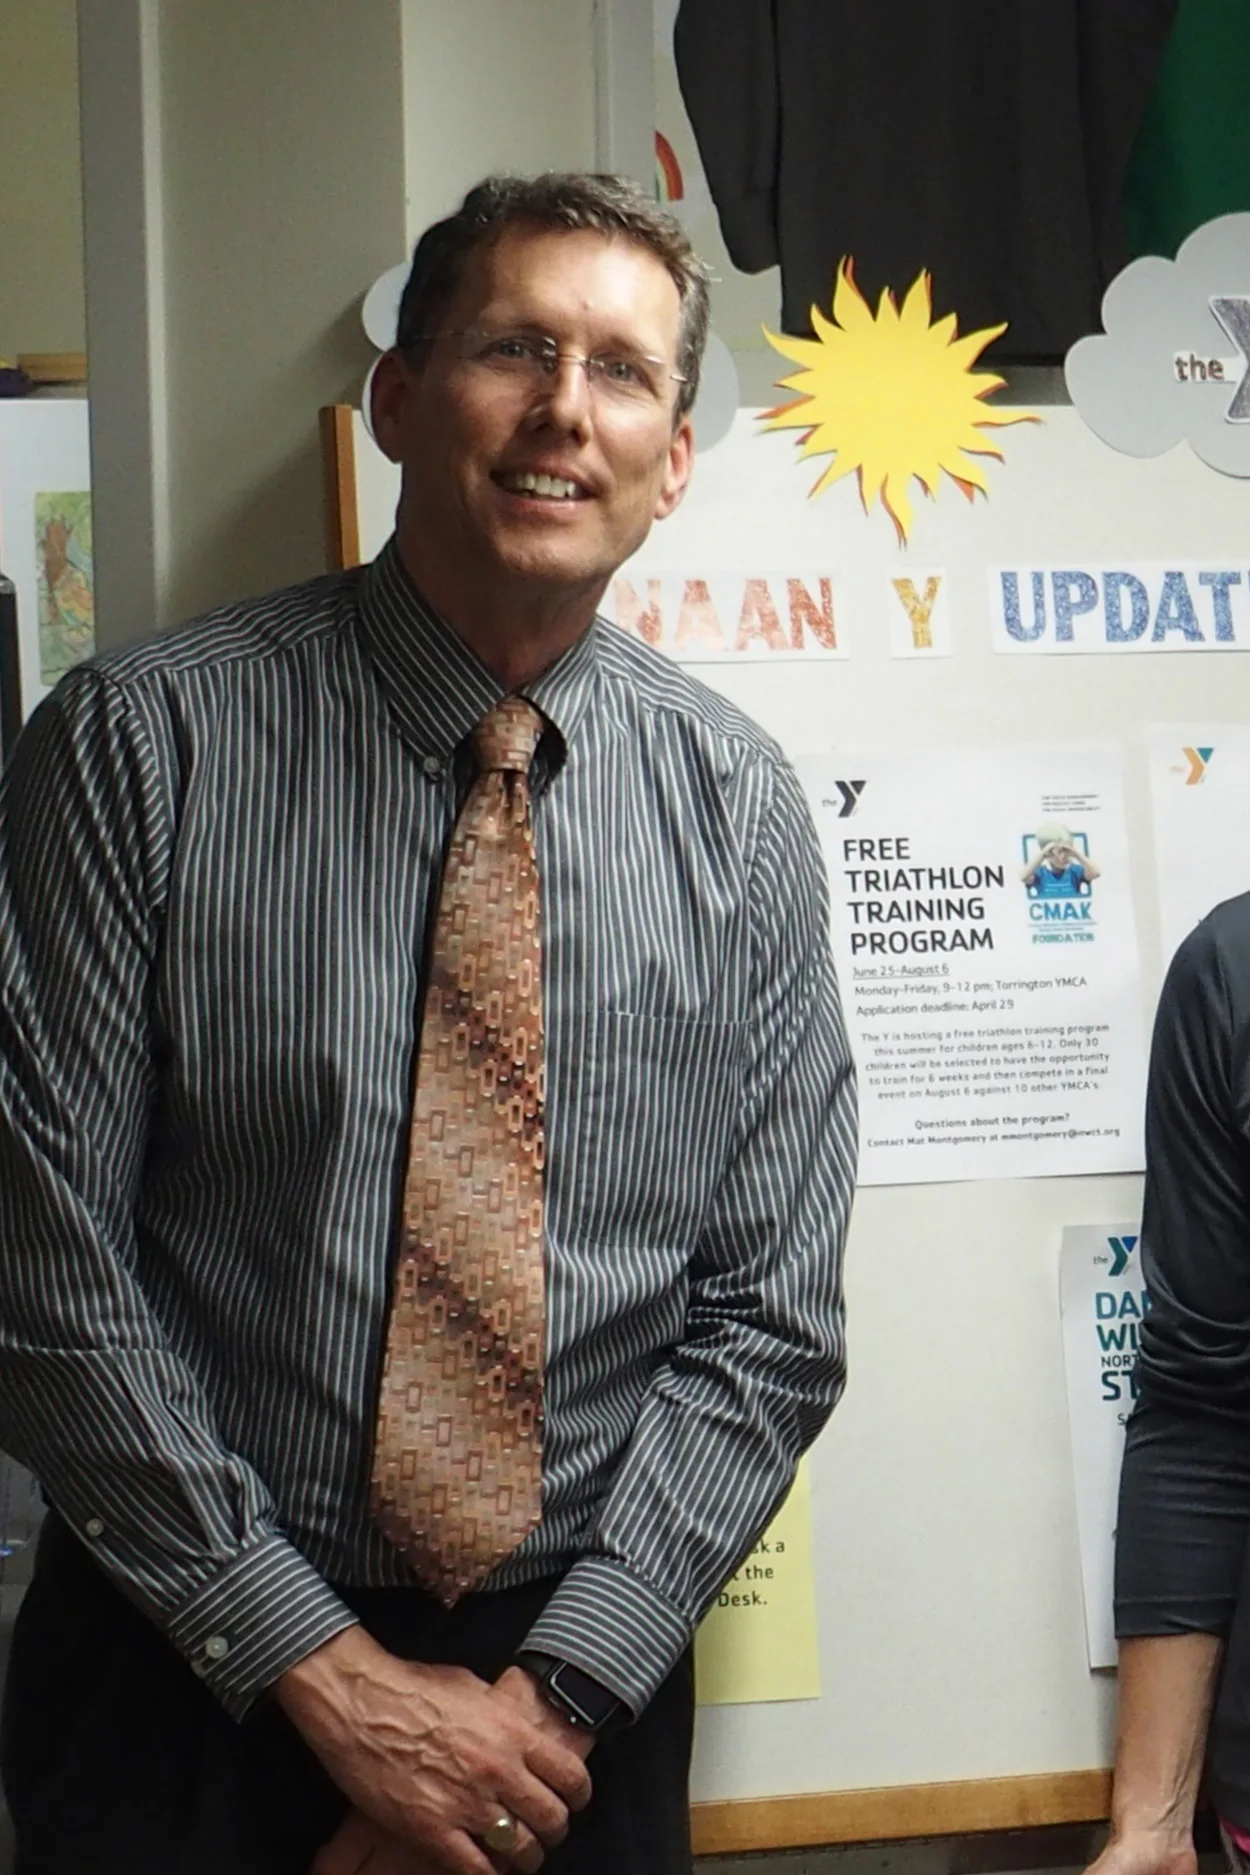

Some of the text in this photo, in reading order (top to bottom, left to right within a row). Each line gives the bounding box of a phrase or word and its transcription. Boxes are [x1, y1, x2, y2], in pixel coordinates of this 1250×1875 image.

[1175, 354, 1224, 381] the
[612, 578, 837, 651] NAAN
[893, 578, 939, 648] Y
[844, 838, 910, 862] FREE
[845, 865, 1004, 893] TRIATHLON
[847, 897, 985, 924] TRAINING
[1029, 902, 1092, 921] CMAK
[851, 928, 994, 955] PROGRAM
[853, 966, 878, 977] June
[942, 963, 949, 974] 6
[996, 979, 1053, 991] Torrington
[1055, 976, 1087, 988] YMCA
[857, 1003, 918, 1017] Application
[972, 1000, 997, 1013] April
[862, 1032, 879, 1042] The
[882, 1032, 889, 1041] Y
[892, 1031, 901, 1041] is
[903, 1030, 942, 1042] hosting
[954, 1028, 974, 1038] free
[978, 1026, 1022, 1037] triathlon
[1025, 1025, 1064, 1036] training
[1067, 1024, 1110, 1035] program
[874, 1047, 893, 1057] this
[897, 1046, 936, 1055] summer
[940, 1044, 954, 1054] for
[957, 1042, 998, 1053] children
[1001, 1042, 1024, 1053] ages
[1060, 1038, 1081, 1050] Only
[865, 1052, 1110, 1072] children will be selected to have the opportunity
[869, 1076, 880, 1086] to
[883, 1075, 908, 1085] train
[910, 1074, 925, 1084] for
[938, 1072, 969, 1082] weeks
[972, 1071, 991, 1081] and
[994, 1070, 1016, 1080] then
[1020, 1068, 1062, 1080] compete
[1065, 1067, 1074, 1076] in
[1085, 1065, 1108, 1075] final
[878, 1090, 906, 1100] event
[909, 1090, 922, 1098] on
[925, 1087, 961, 1099] August
[973, 1085, 1011, 1097] against
[1015, 1083, 1028, 1093] 10
[1030, 1082, 1057, 1092] other
[915, 1112, 1070, 1130] Questions about the program?
[867, 1137, 904, 1148] Contact
[927, 1132, 987, 1145] Montgomery
[989, 1133, 998, 1143] at
[775, 1541, 785, 1553] a
[745, 1564, 774, 1580] the
[718, 1590, 768, 1608] Desk.
